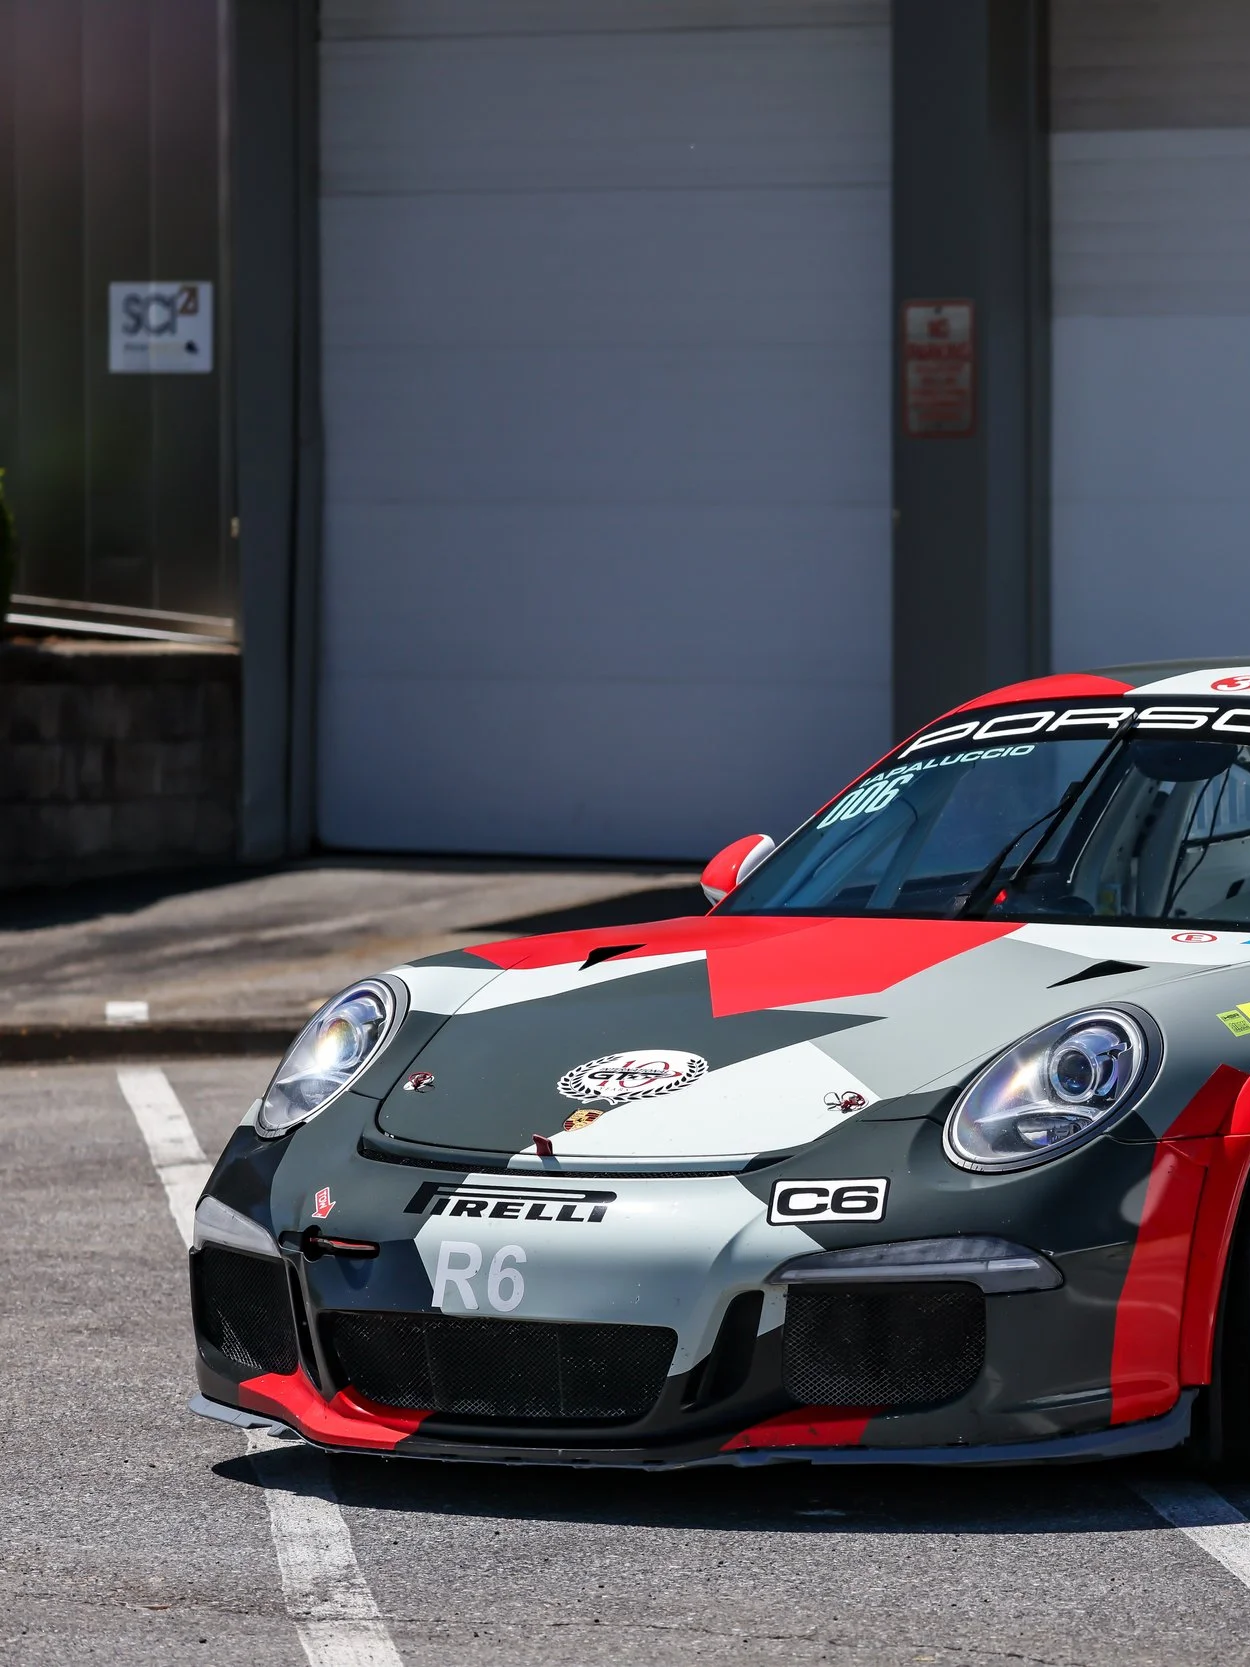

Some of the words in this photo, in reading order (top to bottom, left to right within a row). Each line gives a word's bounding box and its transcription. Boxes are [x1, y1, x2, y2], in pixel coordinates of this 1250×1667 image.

[816, 773, 914, 829] 006
[403, 1181, 618, 1223] PIRELLI
[776, 1185, 880, 1217] C6
[430, 1240, 527, 1313] R6
